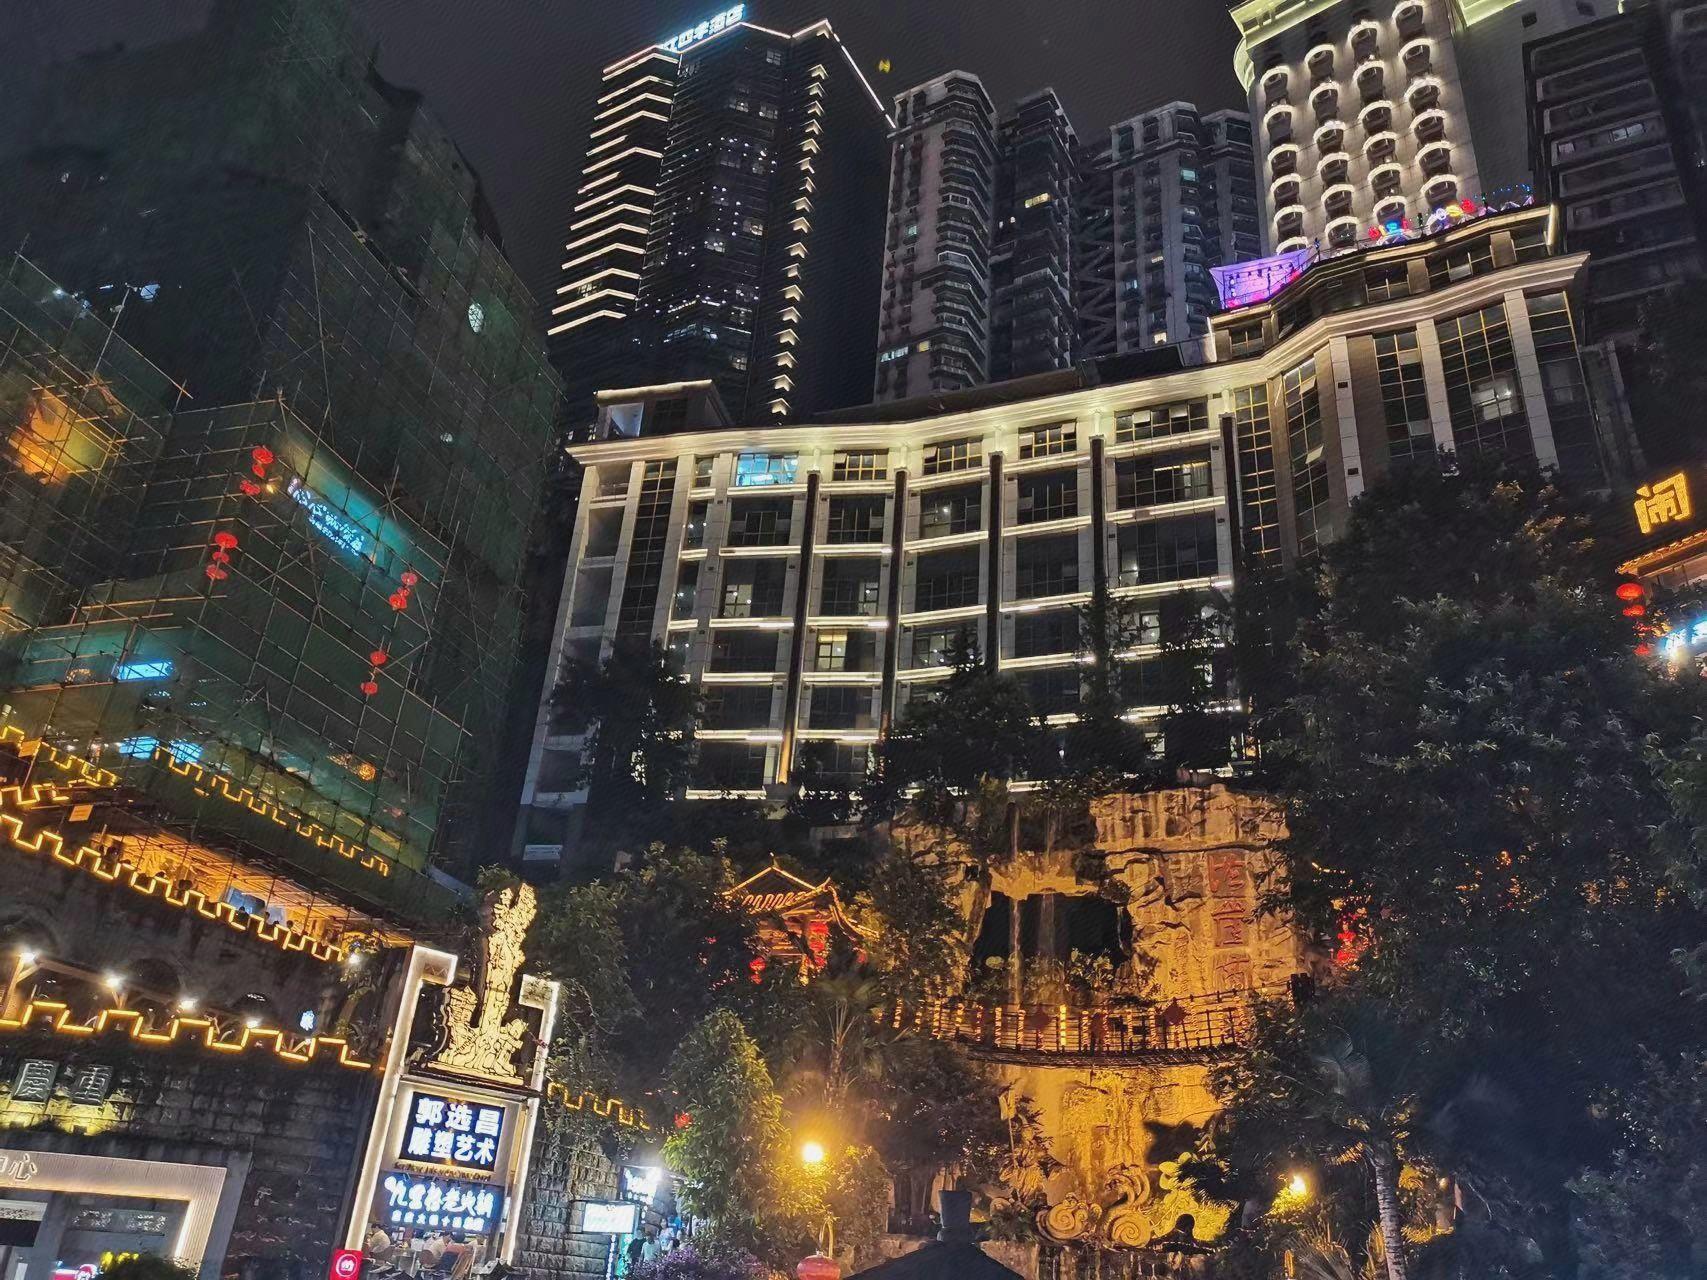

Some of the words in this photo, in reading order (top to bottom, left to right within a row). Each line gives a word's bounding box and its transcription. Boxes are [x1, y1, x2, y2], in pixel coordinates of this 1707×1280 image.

[1634, 473, 1691, 533] 闹
[415, 1098, 500, 1136] 郭选昌
[408, 1127, 495, 1165] 雕塑艺术
